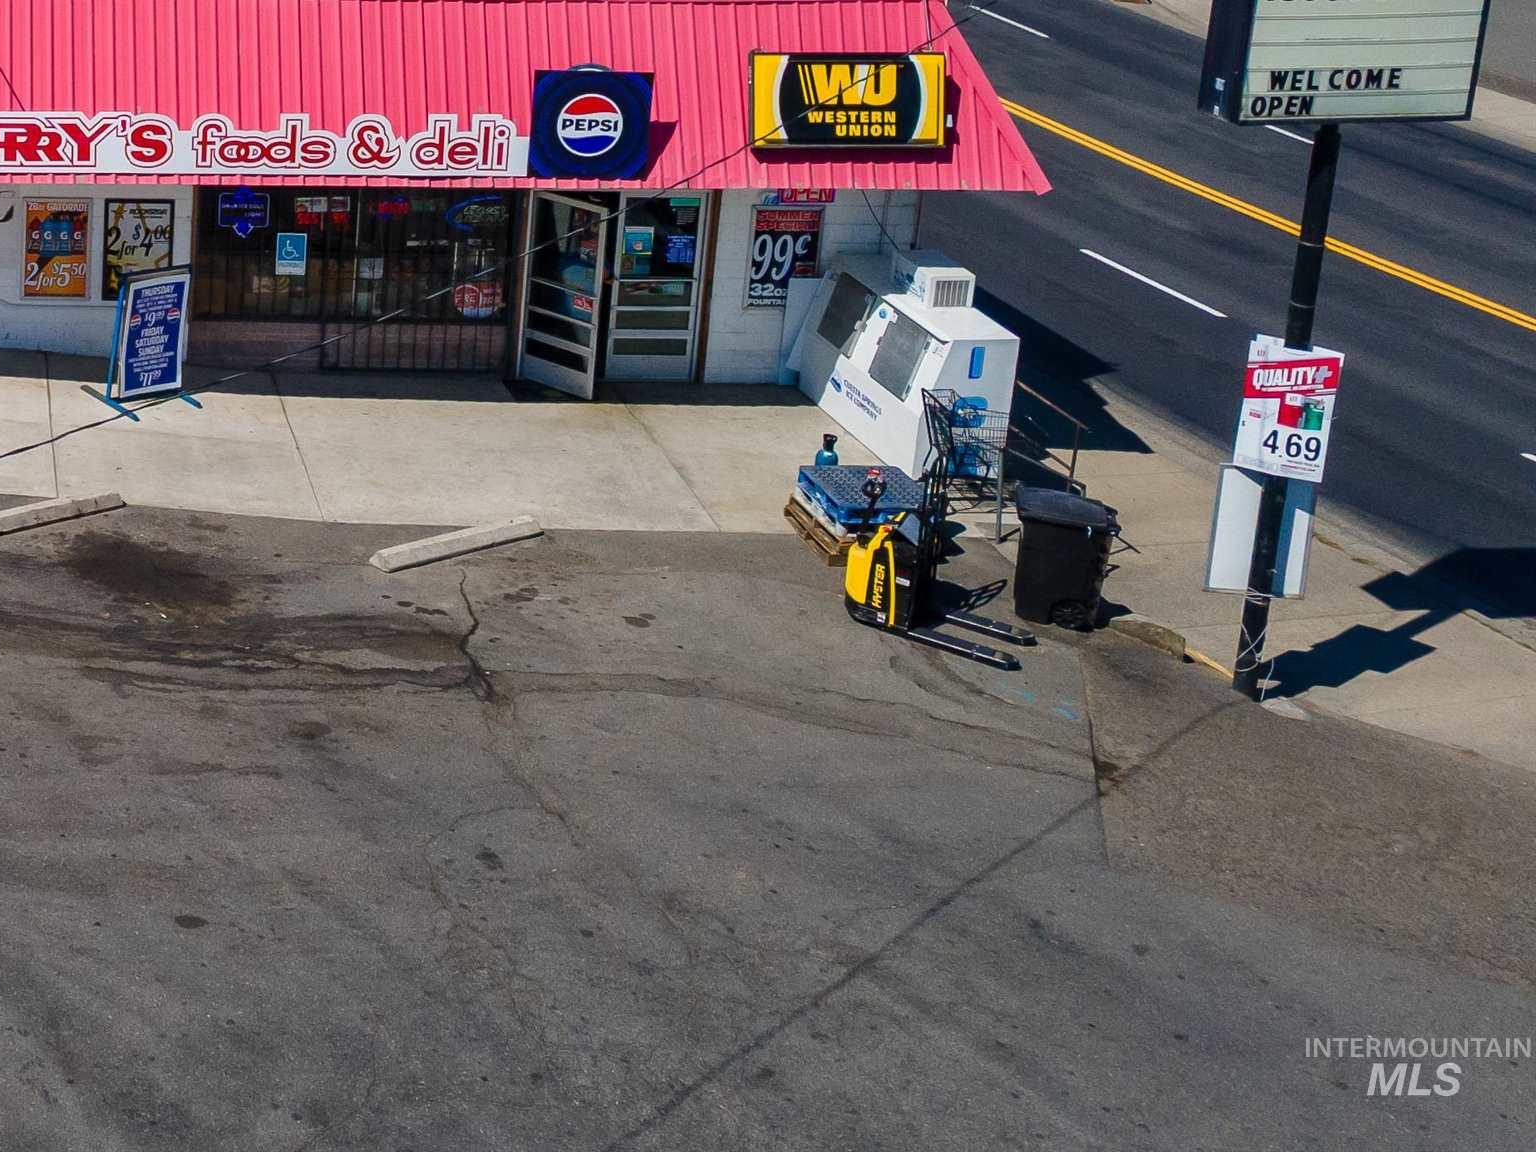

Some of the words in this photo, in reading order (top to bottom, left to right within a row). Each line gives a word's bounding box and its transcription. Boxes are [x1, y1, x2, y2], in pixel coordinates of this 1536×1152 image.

[811, 64, 897, 106] WU
[1250, 96, 1314, 117] OPEN
[807, 111, 896, 124] WESTERN
[561, 118, 619, 133] PEPSI
[835, 124, 896, 137] UNION
[193, 116, 336, 168] foods
[347, 117, 401, 170] &
[410, 118, 512, 171] deli
[32, 230, 40, 239] G
[44, 231, 52, 240] G
[60, 231, 68, 240] G
[74, 231, 82, 240] G
[106, 225, 121, 255] 2
[119, 240, 140, 259] for
[24, 262, 39, 285] 2
[36, 275, 57, 291] for
[141, 326, 165, 338] FRIDAY
[135, 334, 170, 349] SATURDAY
[138, 344, 165, 357] SUNDAY
[871, 563, 886, 609] HYSTER
